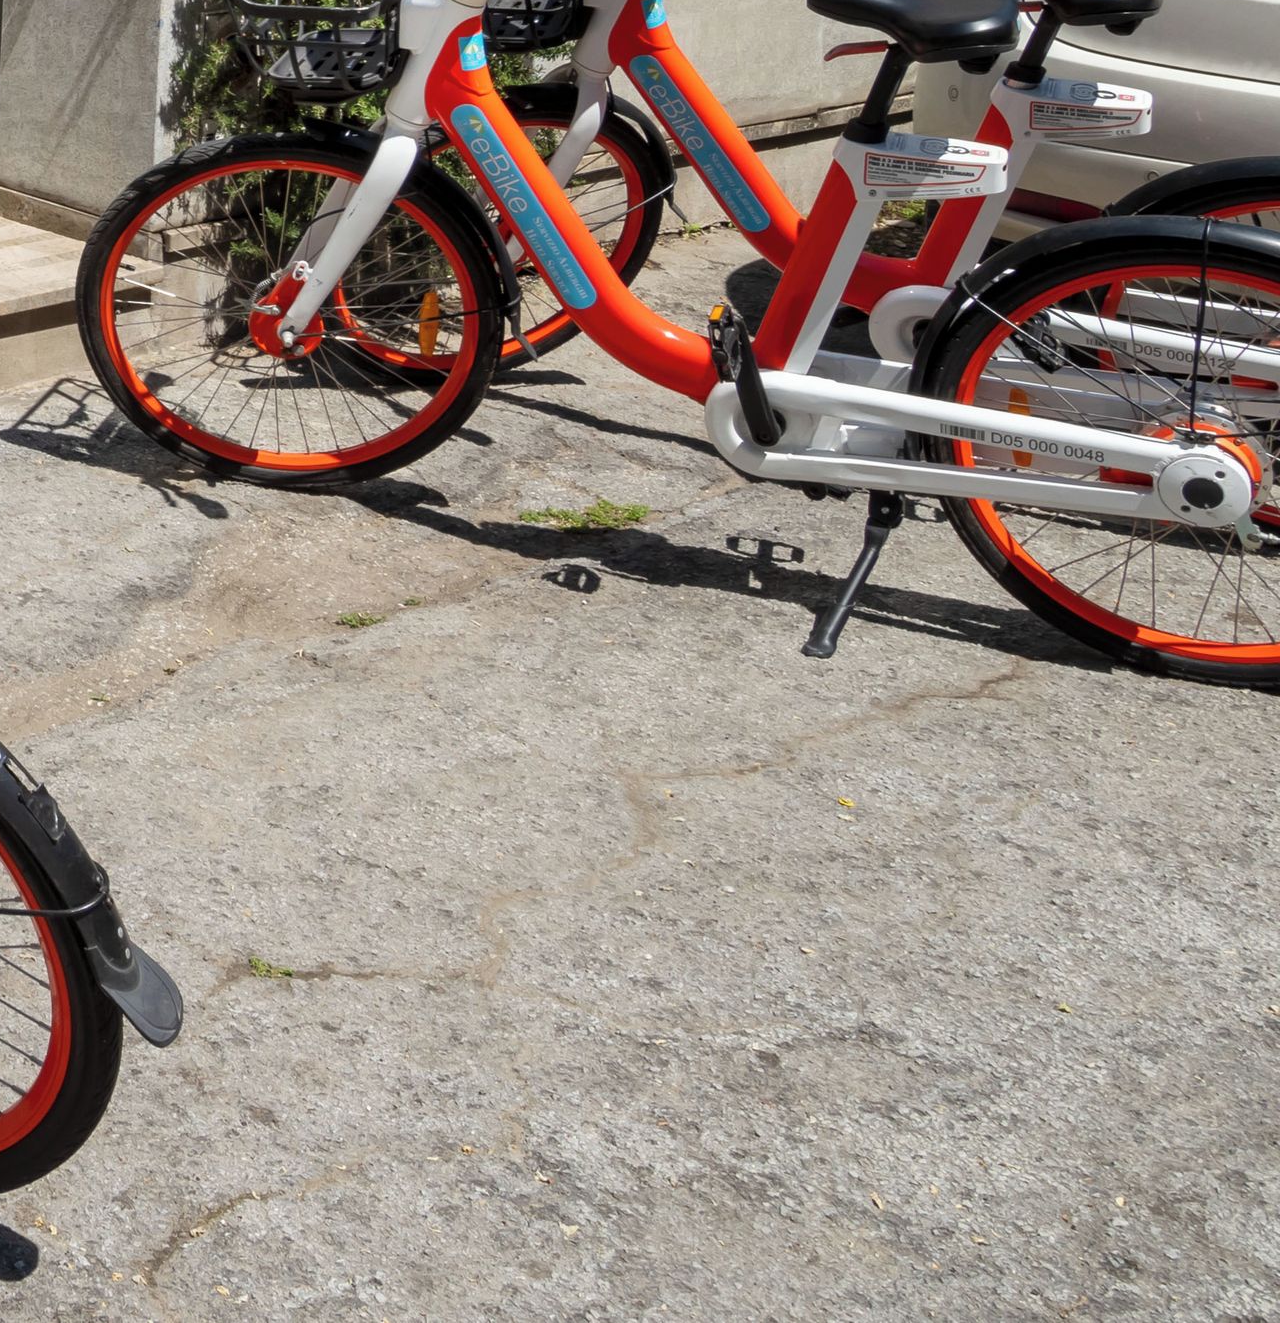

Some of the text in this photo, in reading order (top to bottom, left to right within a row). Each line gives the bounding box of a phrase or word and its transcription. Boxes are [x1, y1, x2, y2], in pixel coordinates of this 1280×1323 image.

[649, 83, 704, 153] e-Bike
[470, 136, 528, 214] e-Bike
[1166, 348, 1193, 363] 000
[991, 431, 1105, 463] D05 000 0048
